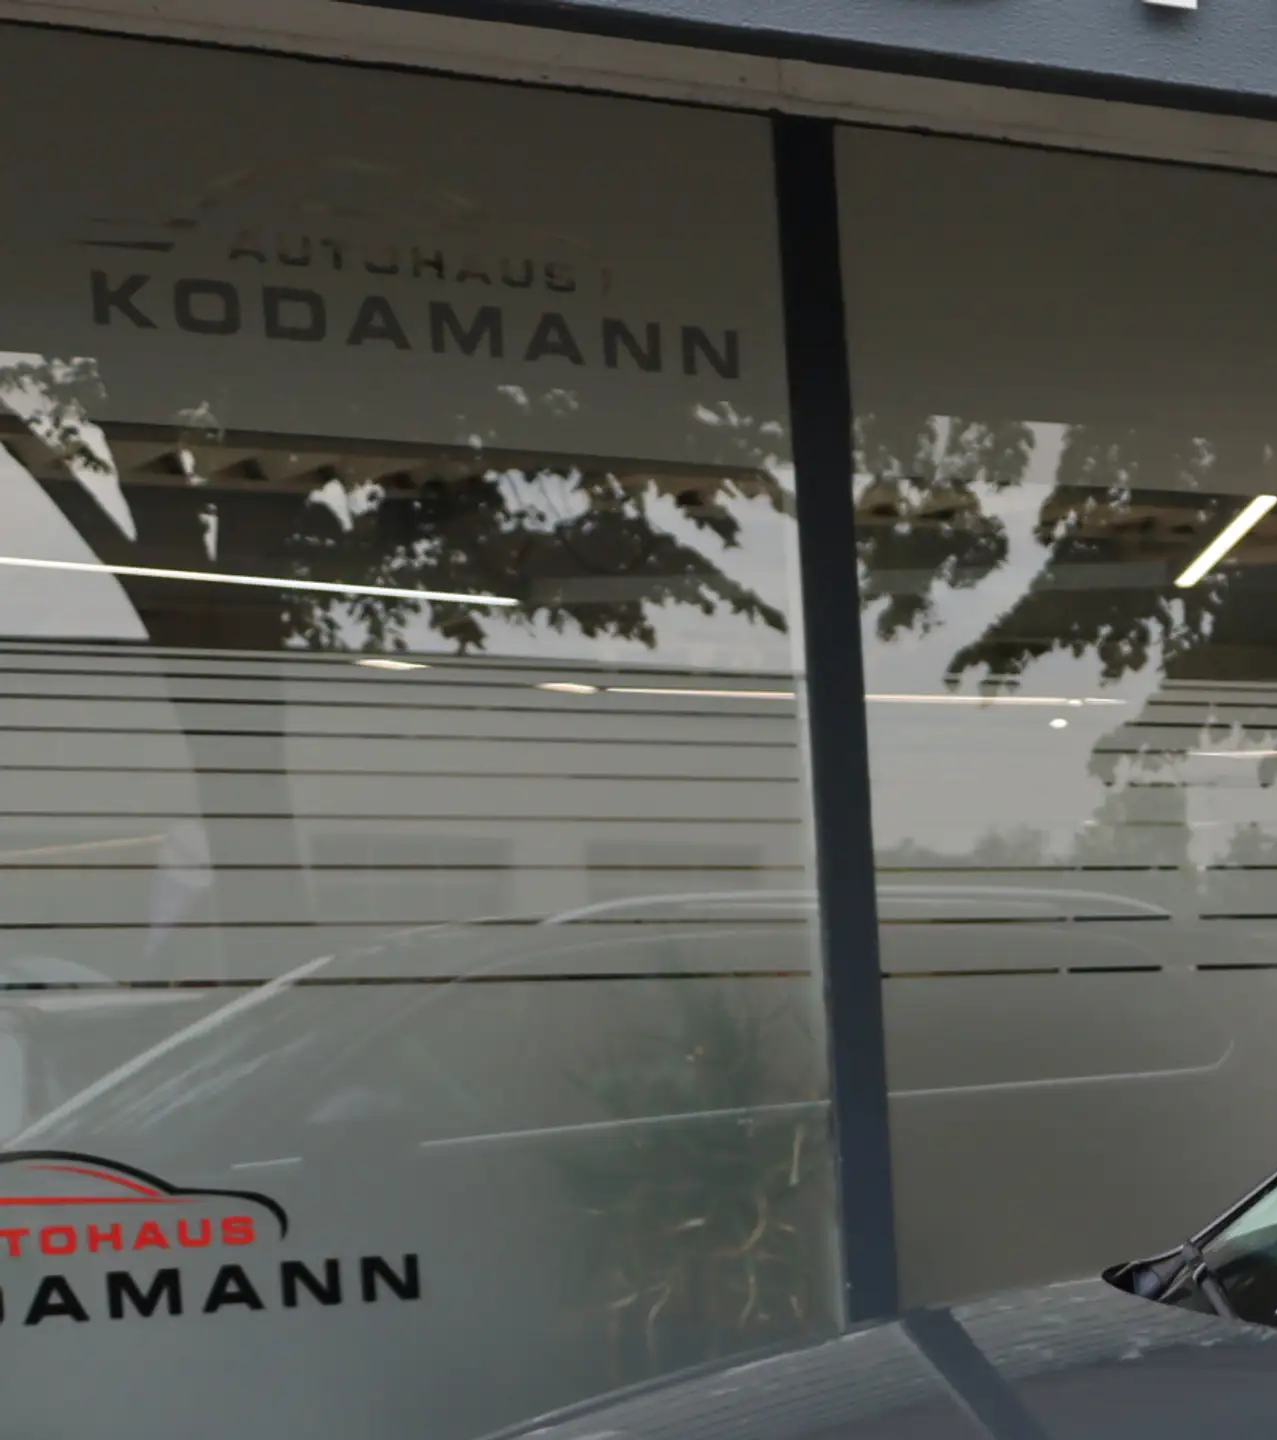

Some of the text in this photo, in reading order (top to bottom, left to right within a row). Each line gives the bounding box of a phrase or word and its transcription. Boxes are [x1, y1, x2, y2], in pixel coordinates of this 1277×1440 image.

[89, 269, 742, 381] KODAMANN
[0, 1216, 256, 1257] TOHAUS
[0, 1253, 421, 1328] AMANN
